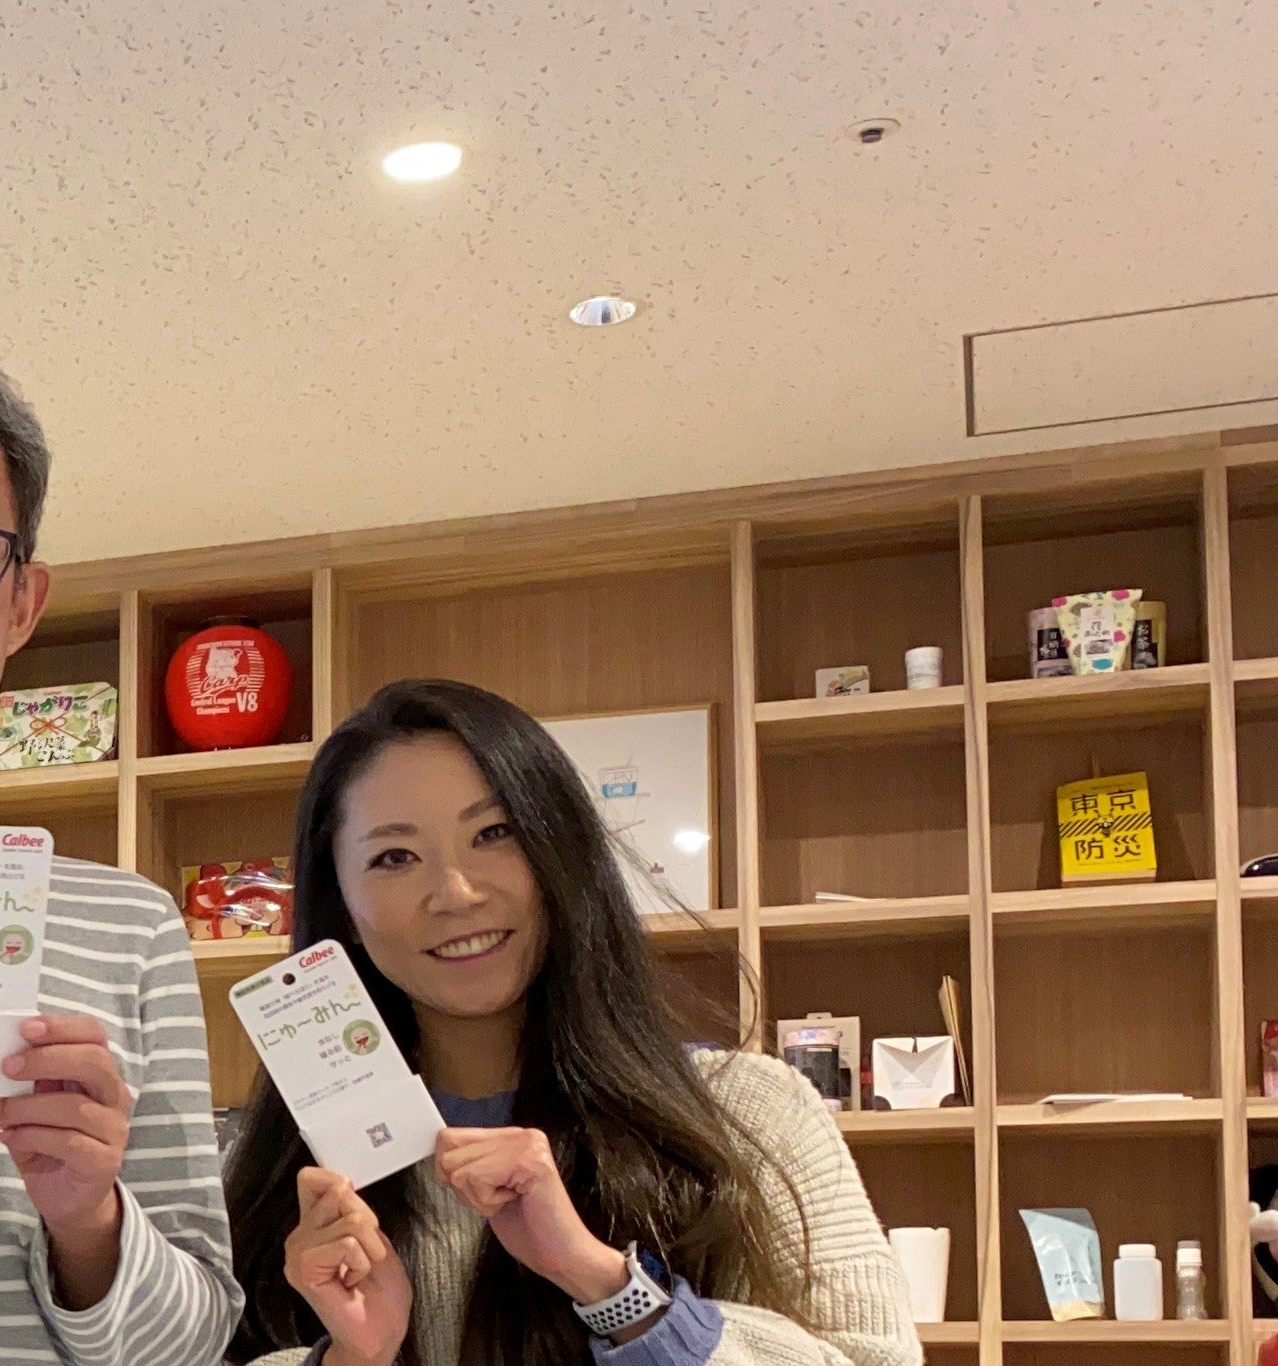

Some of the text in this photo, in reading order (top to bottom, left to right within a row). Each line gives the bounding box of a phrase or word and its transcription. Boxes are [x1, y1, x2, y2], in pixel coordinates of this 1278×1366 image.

[12, 695, 89, 717] じゃがりこ
[236, 691, 258, 712] V8
[1070, 789, 1137, 816] 東京
[2, 833, 45, 848] Calbee
[1074, 834, 1141, 861] 防災
[299, 946, 335, 968] Calbee
